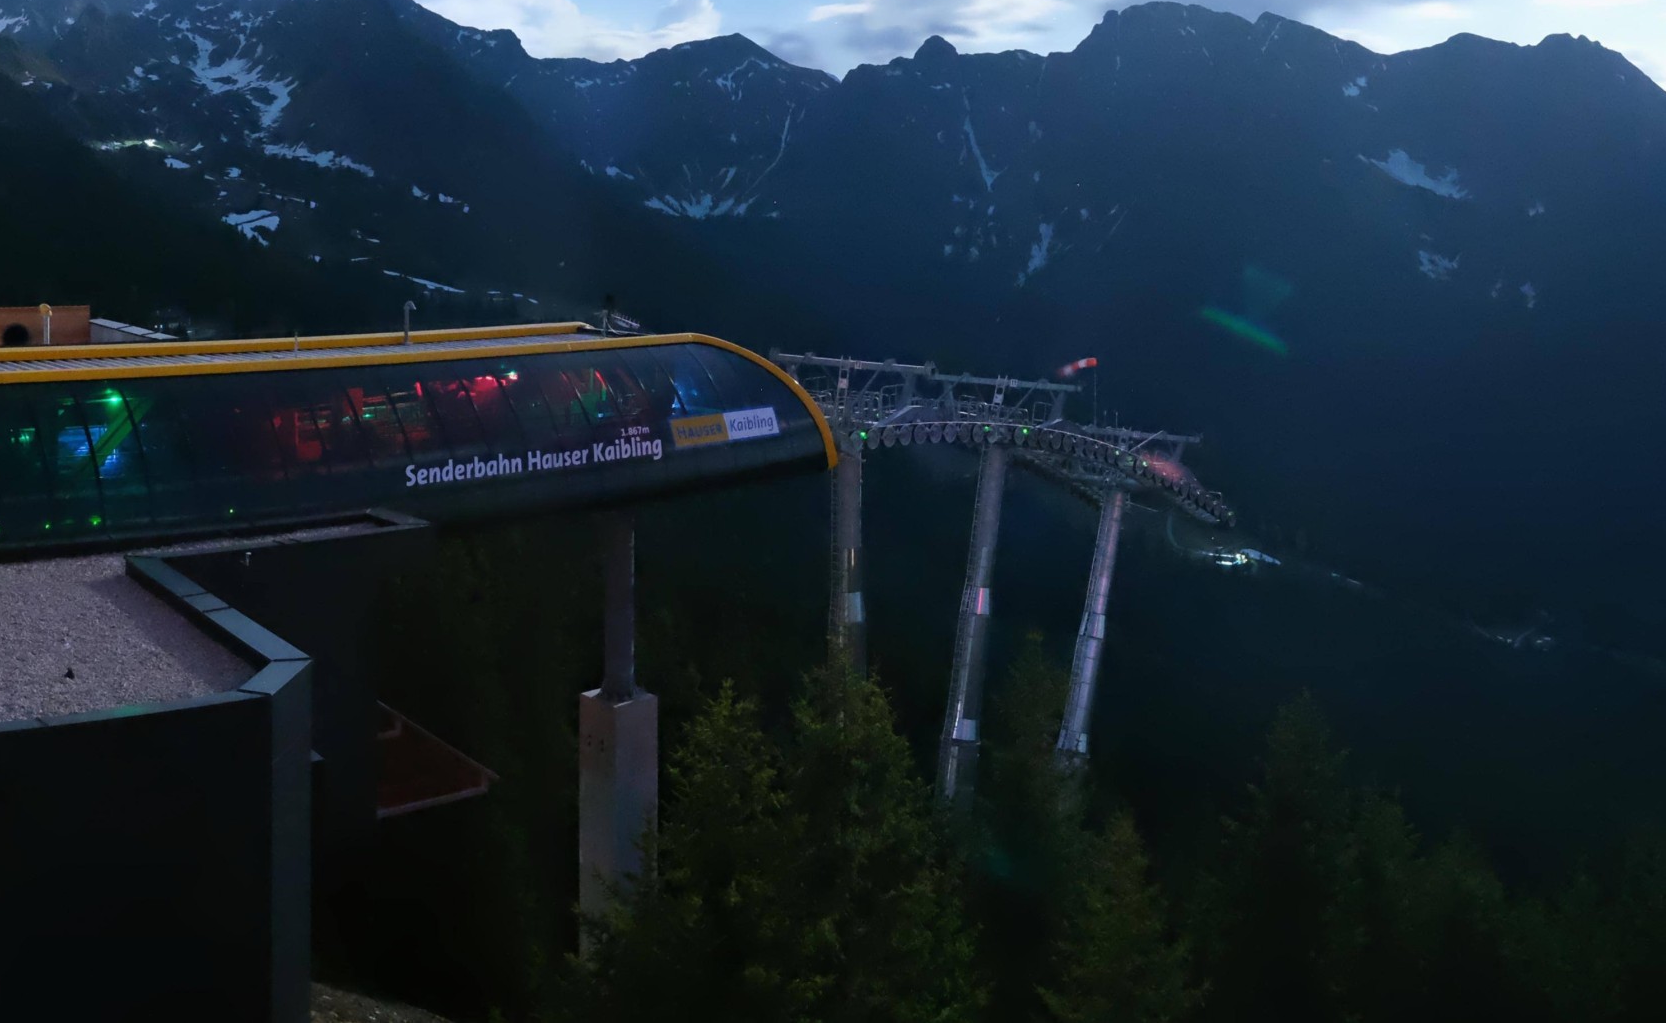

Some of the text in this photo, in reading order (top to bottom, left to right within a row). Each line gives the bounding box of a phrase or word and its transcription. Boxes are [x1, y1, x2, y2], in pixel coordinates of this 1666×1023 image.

[620, 426, 650, 437] 1.867m
[729, 414, 774, 433] Kaibling
[405, 436, 662, 487] Senderbahn Hauser Kaibling
